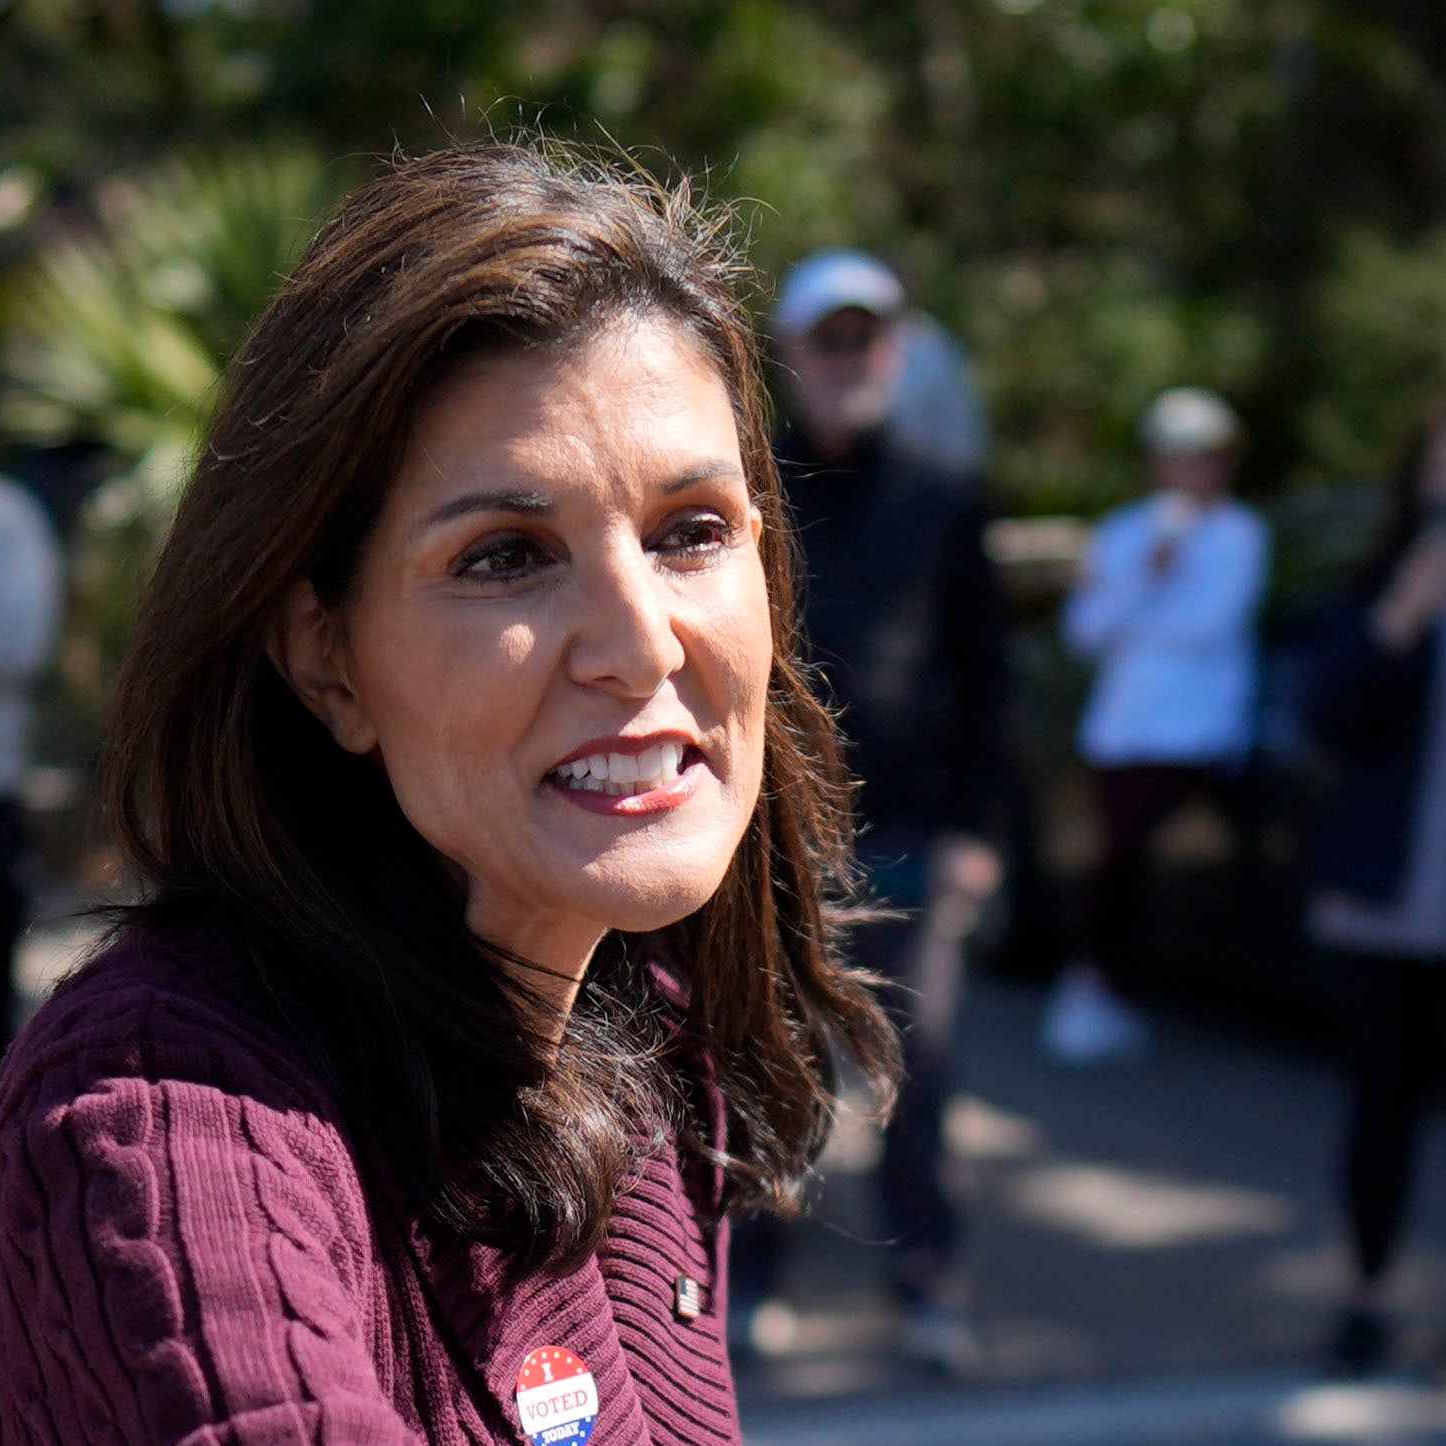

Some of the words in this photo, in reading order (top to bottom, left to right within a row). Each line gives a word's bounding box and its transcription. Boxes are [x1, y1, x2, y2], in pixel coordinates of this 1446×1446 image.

[541, 1362, 553, 1382] I
[526, 1390, 588, 1421] VOTED
[541, 1421, 580, 1444] TODAY
